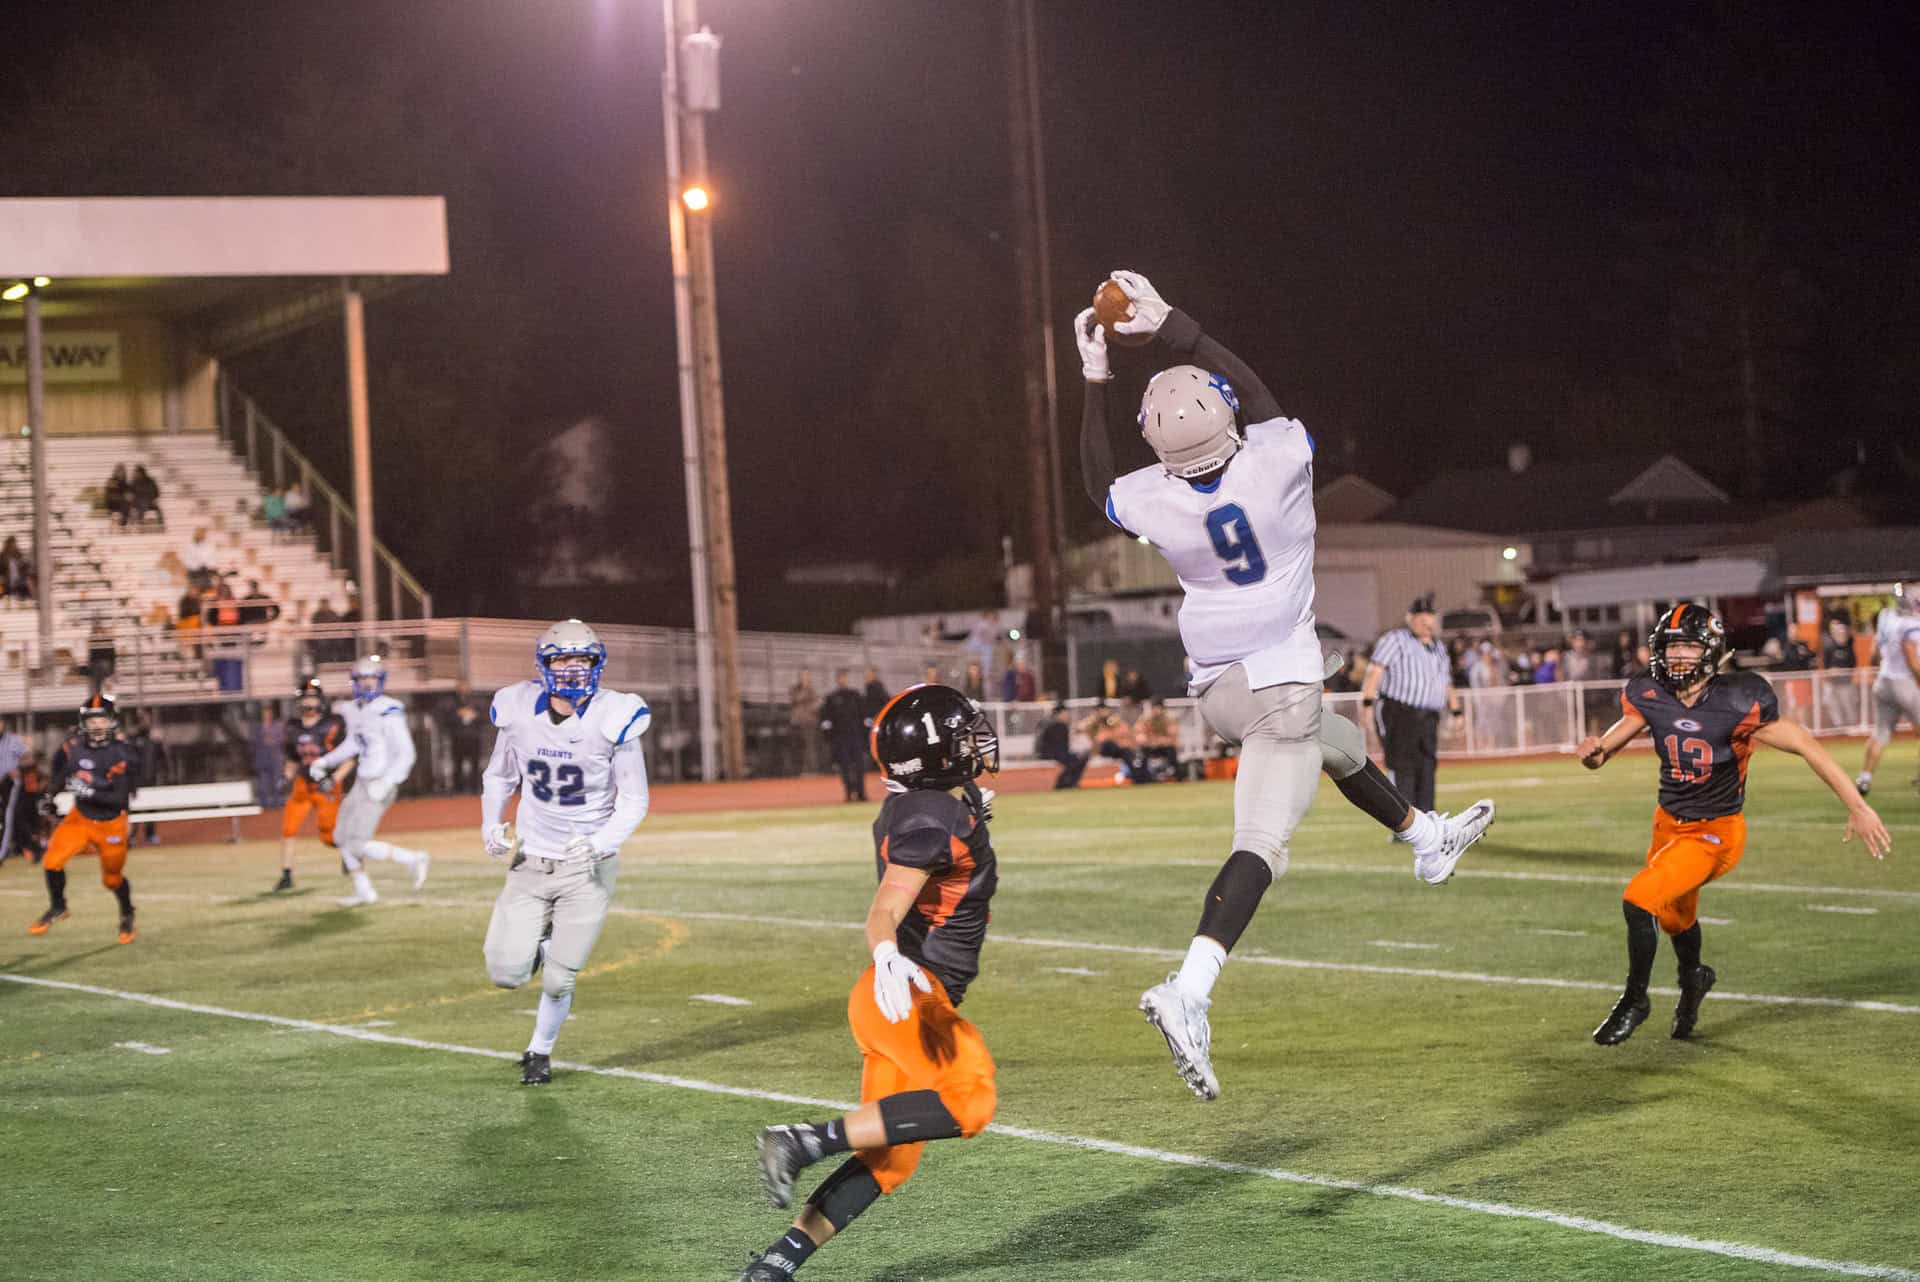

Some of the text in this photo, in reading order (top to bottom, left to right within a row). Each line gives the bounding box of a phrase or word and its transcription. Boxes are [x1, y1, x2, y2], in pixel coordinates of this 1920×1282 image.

[1206, 501, 1268, 586] 9
[920, 711, 941, 745] 1
[527, 759, 587, 806] 32
[1664, 734, 1714, 784] 13
